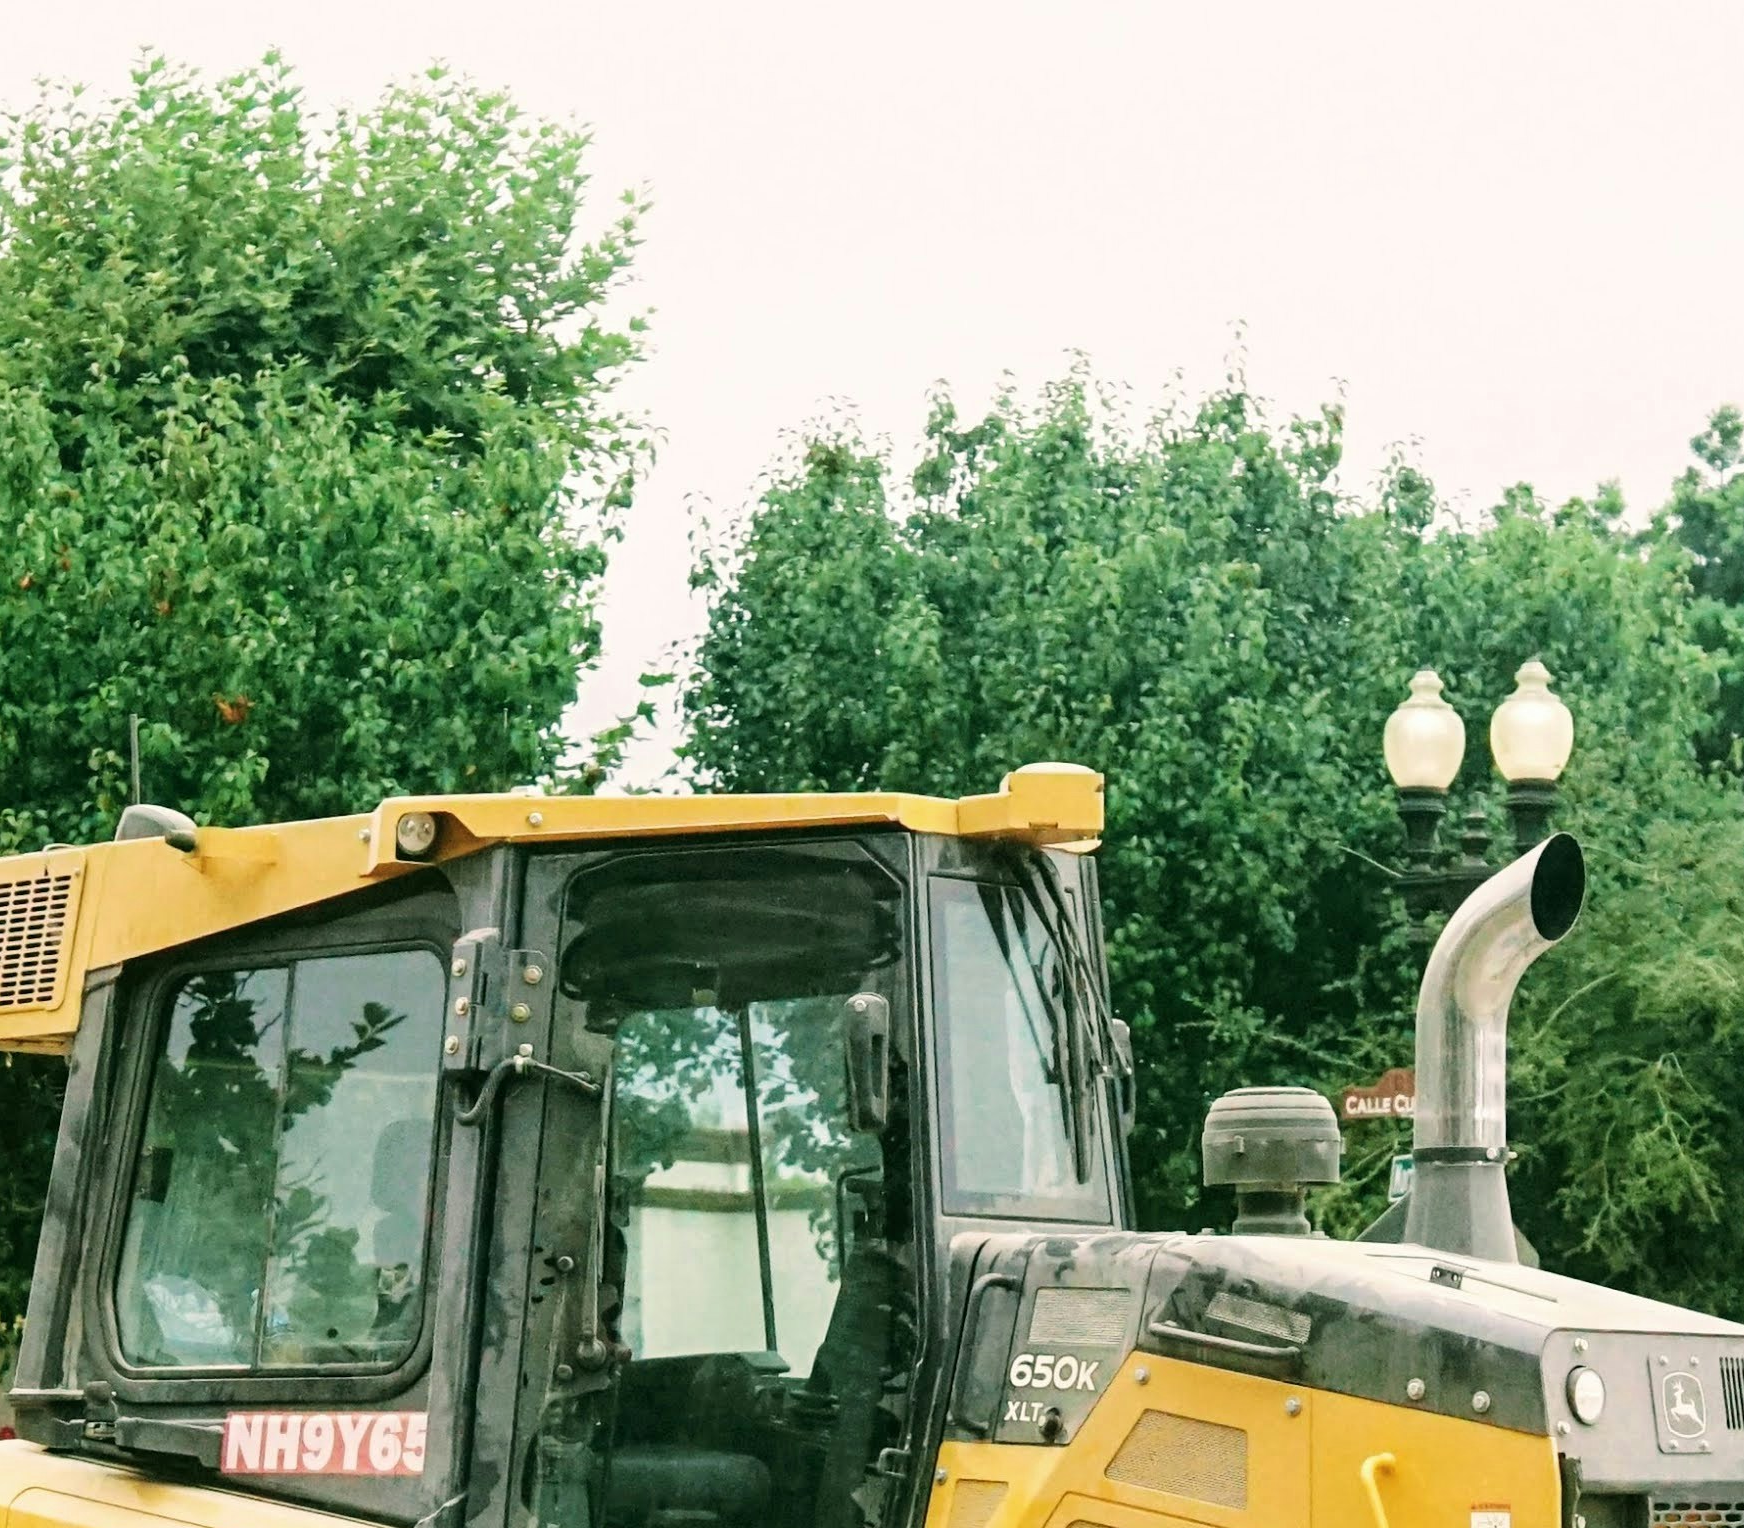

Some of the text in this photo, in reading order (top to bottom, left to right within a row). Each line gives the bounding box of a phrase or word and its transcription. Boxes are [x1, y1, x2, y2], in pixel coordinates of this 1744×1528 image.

[1345, 1095, 1391, 1114] CALLE
[1010, 1353, 1099, 1391] 650K
[1003, 1401, 1044, 1422] XLT
[225, 1413, 429, 1472] NH9Y65
